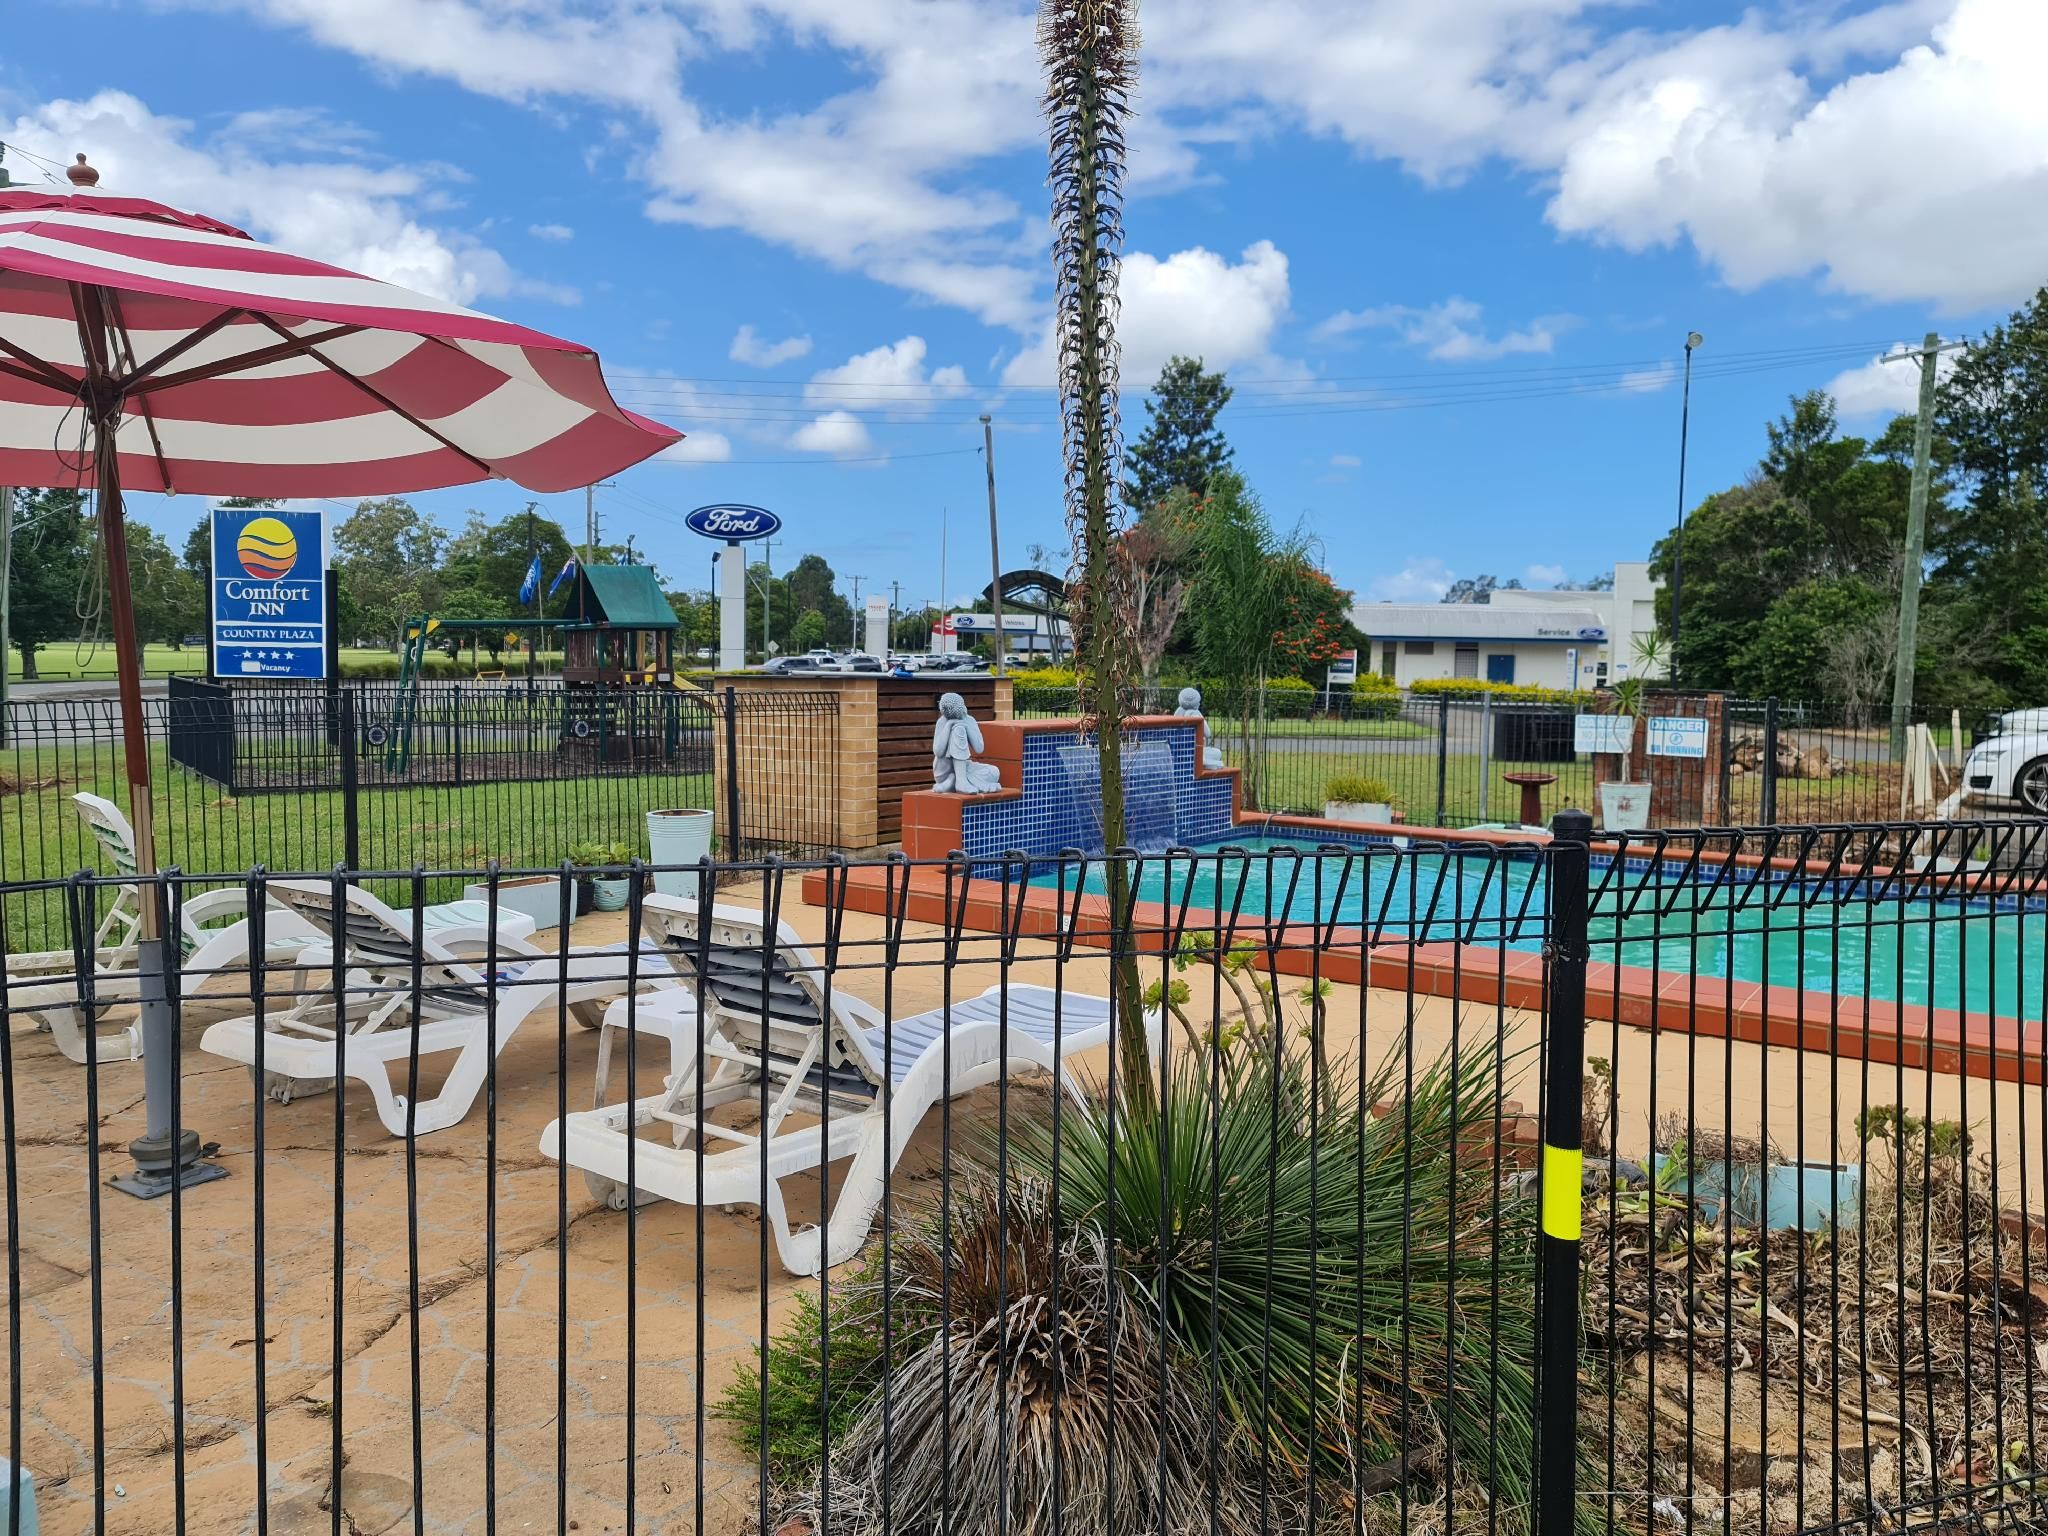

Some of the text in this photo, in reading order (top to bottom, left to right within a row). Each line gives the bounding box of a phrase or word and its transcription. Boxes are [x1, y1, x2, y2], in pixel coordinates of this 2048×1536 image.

[704, 508, 760, 532] Ford
[225, 580, 310, 601] Comfort
[249, 602, 285, 616] INN
[223, 629, 314, 640] COUNTRY PLAZA
[1538, 628, 1570, 636] Service
[260, 663, 291, 673] Vacancy
[1651, 719, 1704, 732] DANGER
